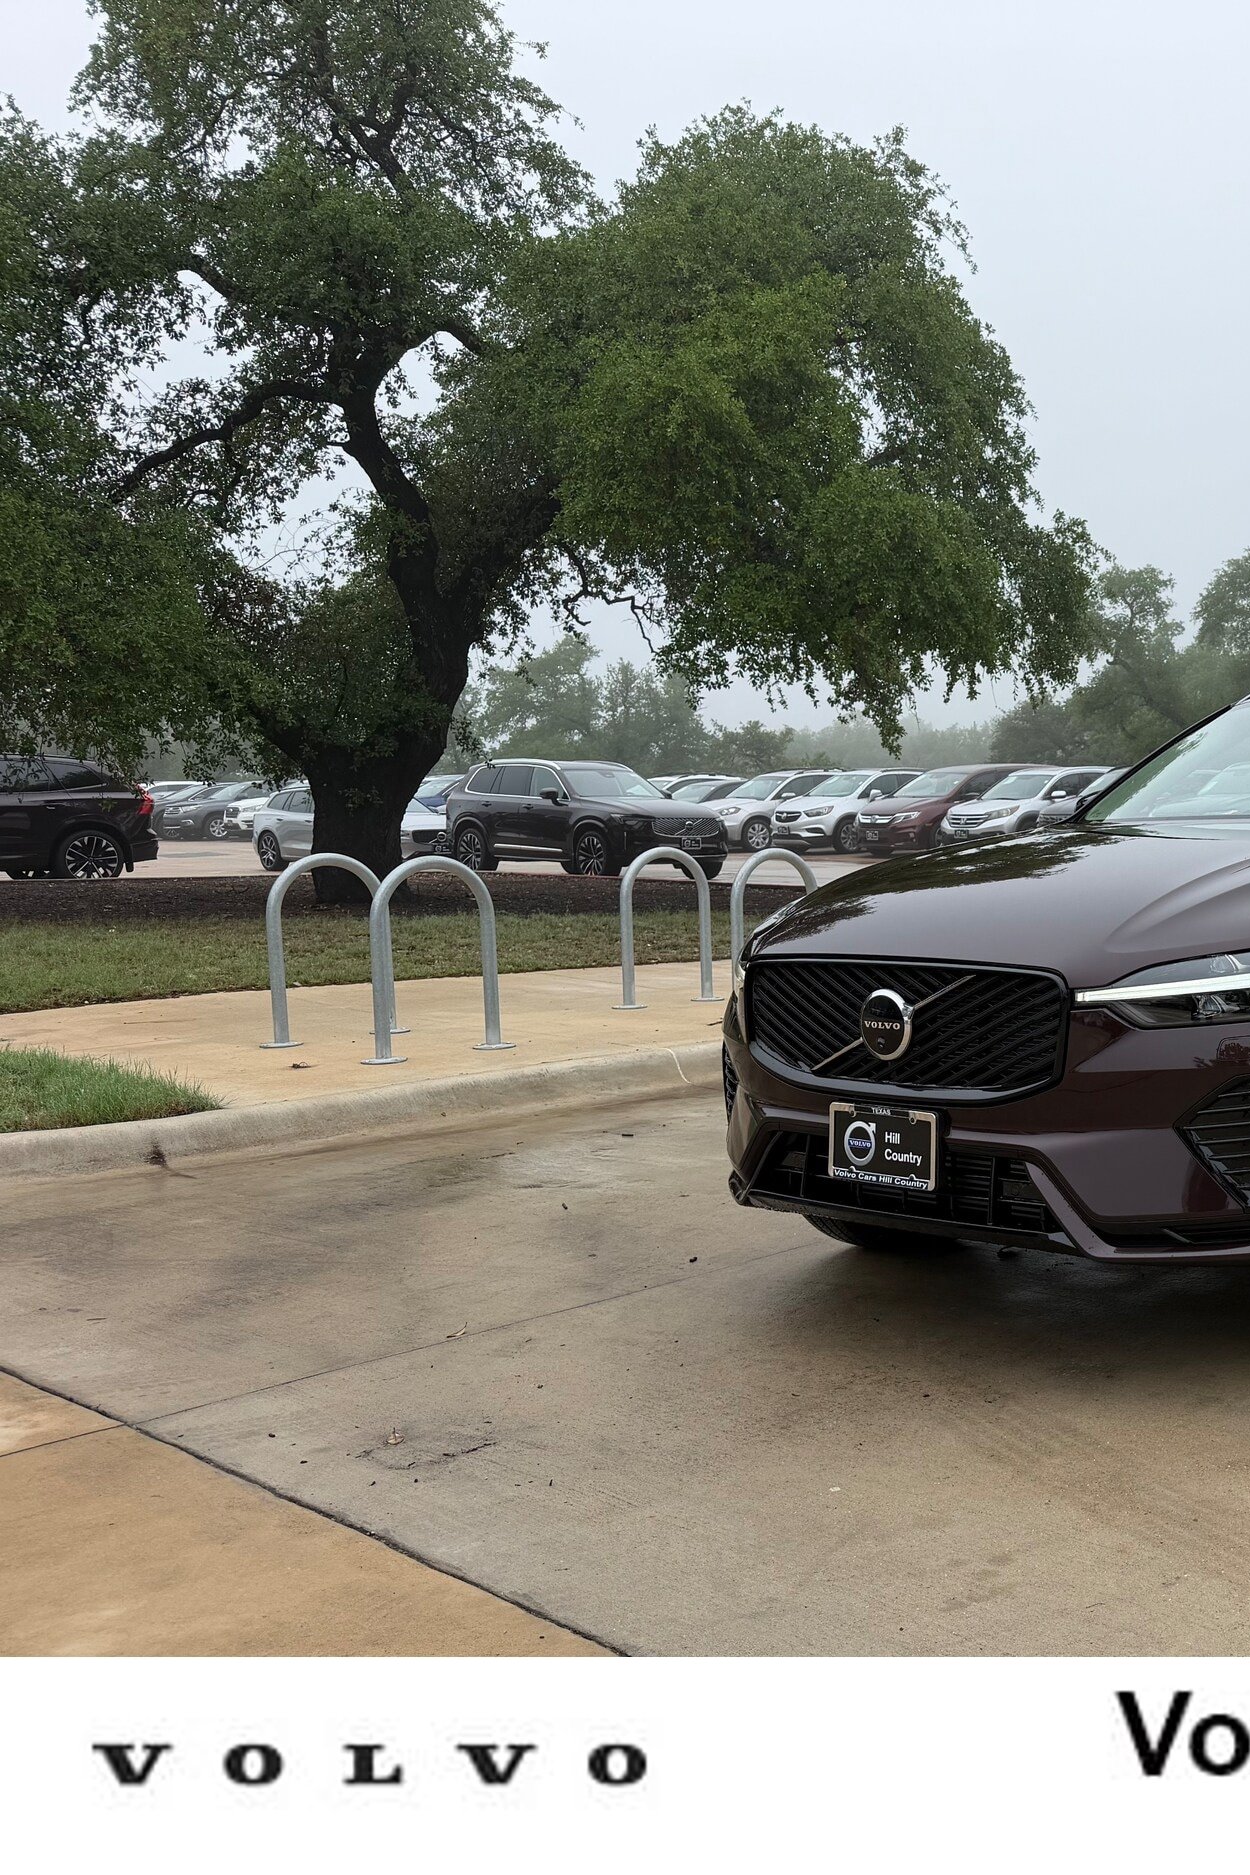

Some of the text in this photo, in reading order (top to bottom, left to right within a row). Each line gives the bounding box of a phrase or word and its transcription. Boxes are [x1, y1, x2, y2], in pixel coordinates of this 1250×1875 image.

[863, 1020, 901, 1030] VOLVO
[871, 1107, 891, 1116] TEXAS
[848, 1140, 872, 1148] VOLVO
[884, 1131, 901, 1145] Hill
[884, 1148, 923, 1167] Country
[834, 1169, 928, 1190] Volvo Cars Hill Country
